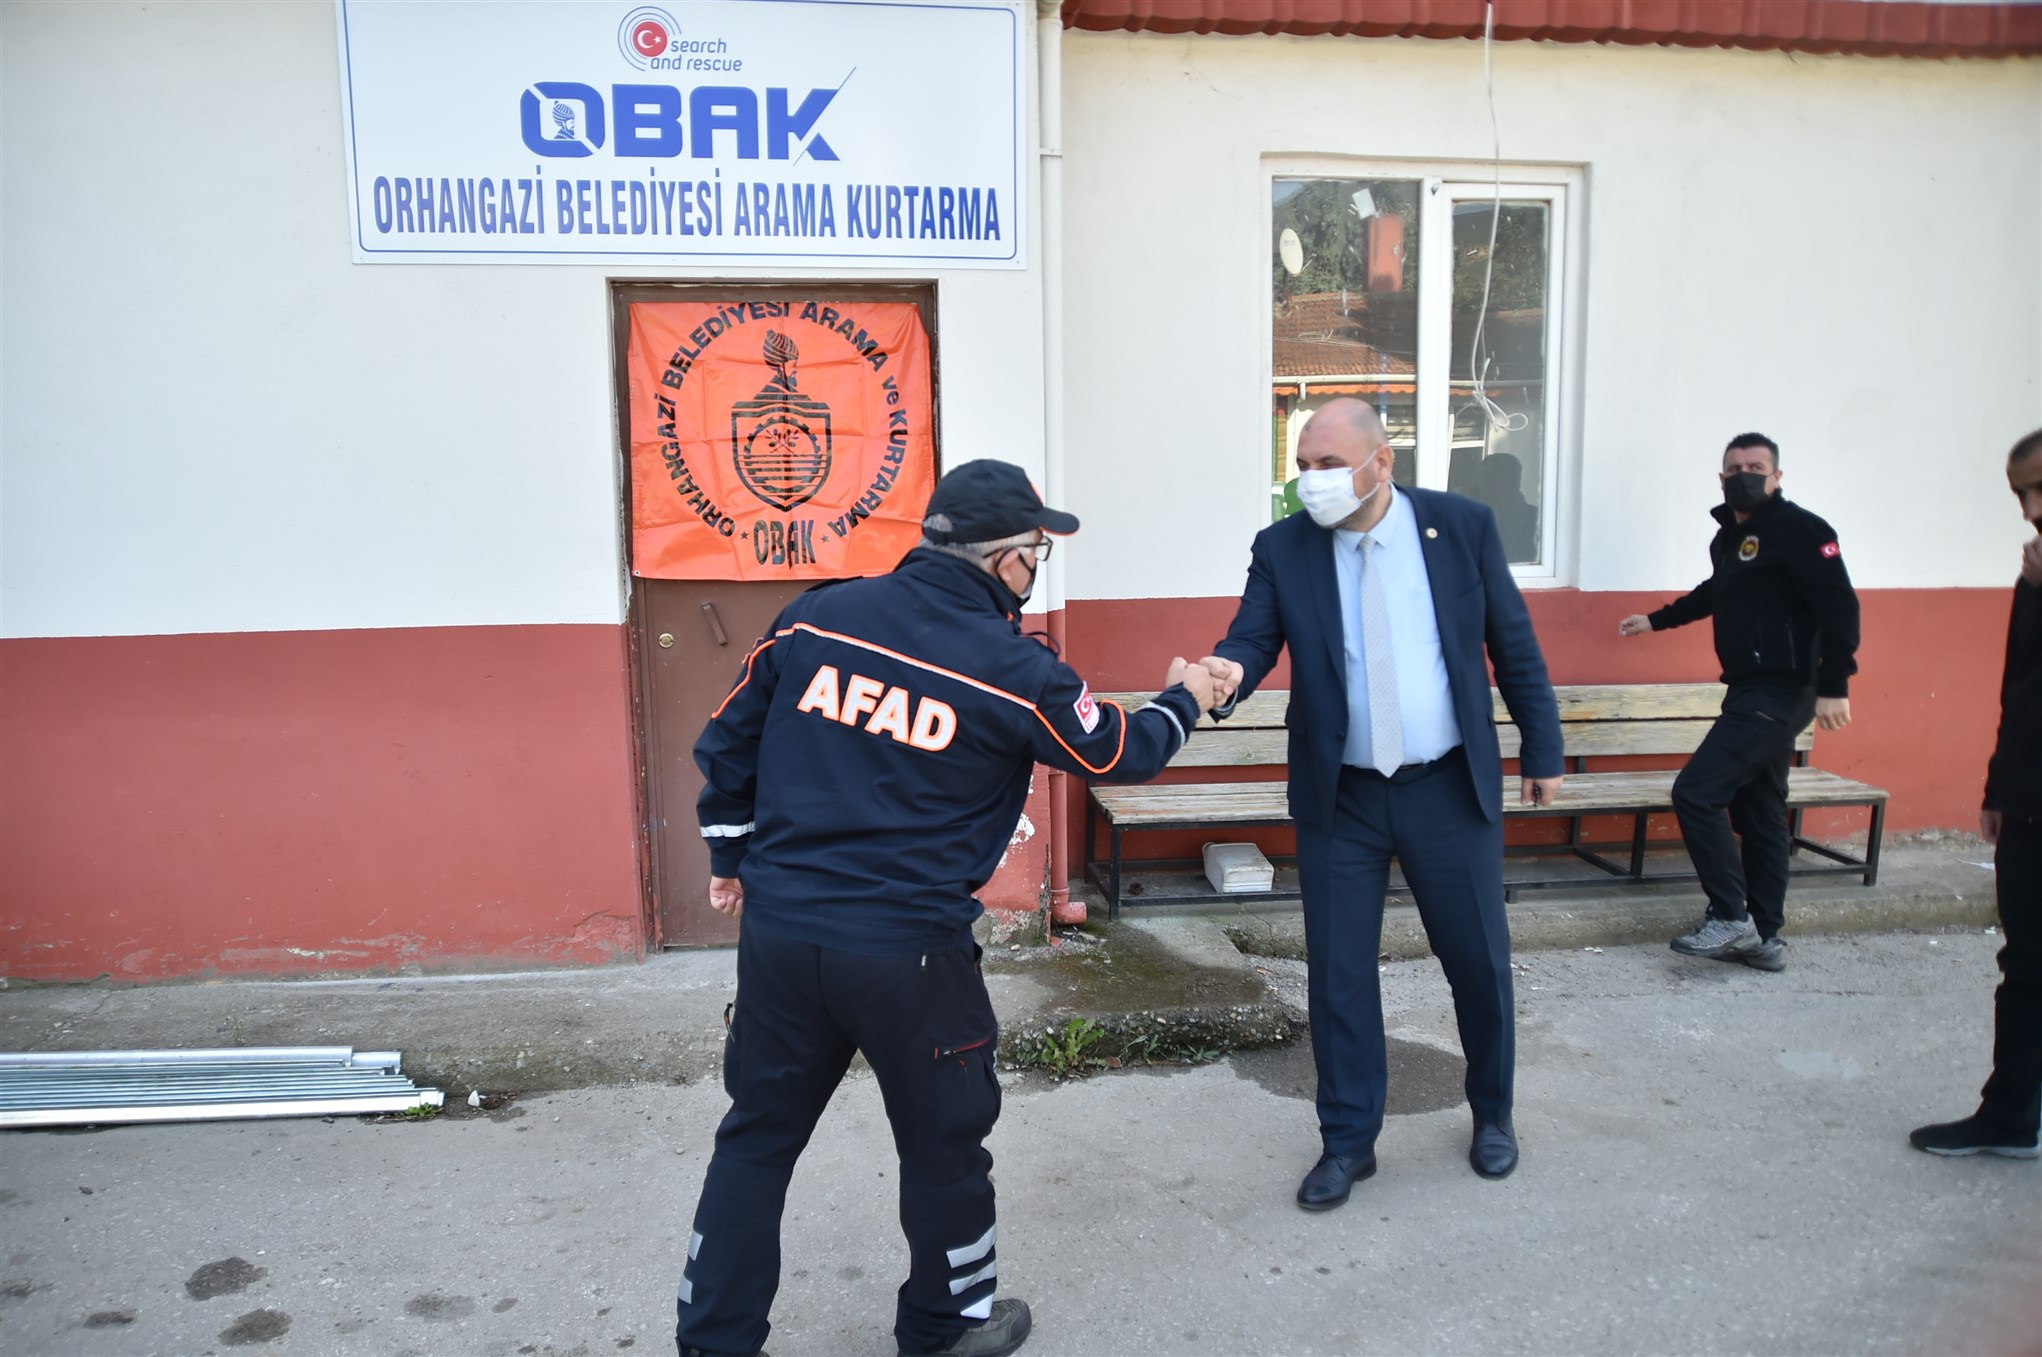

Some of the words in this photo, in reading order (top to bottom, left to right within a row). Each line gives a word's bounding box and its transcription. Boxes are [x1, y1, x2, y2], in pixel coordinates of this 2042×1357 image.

[650, 54, 682, 70] and
[686, 58, 743, 72] rescue
[670, 37, 727, 53] search
[520, 81, 842, 162] OBAK
[373, 164, 543, 235] ORHANGAZİ
[556, 166, 722, 237] BELEDİYESİ
[735, 182, 836, 238] ARAMA
[846, 184, 1001, 241] KURTARMA
[800, 302, 888, 372] ARAMA
[881, 376, 900, 405] ve
[653, 394, 736, 538] ORHANGAZİ
[826, 408, 909, 538] KURTARMA
[753, 519, 817, 569] OBAK
[796, 664, 957, 752] AFAD
